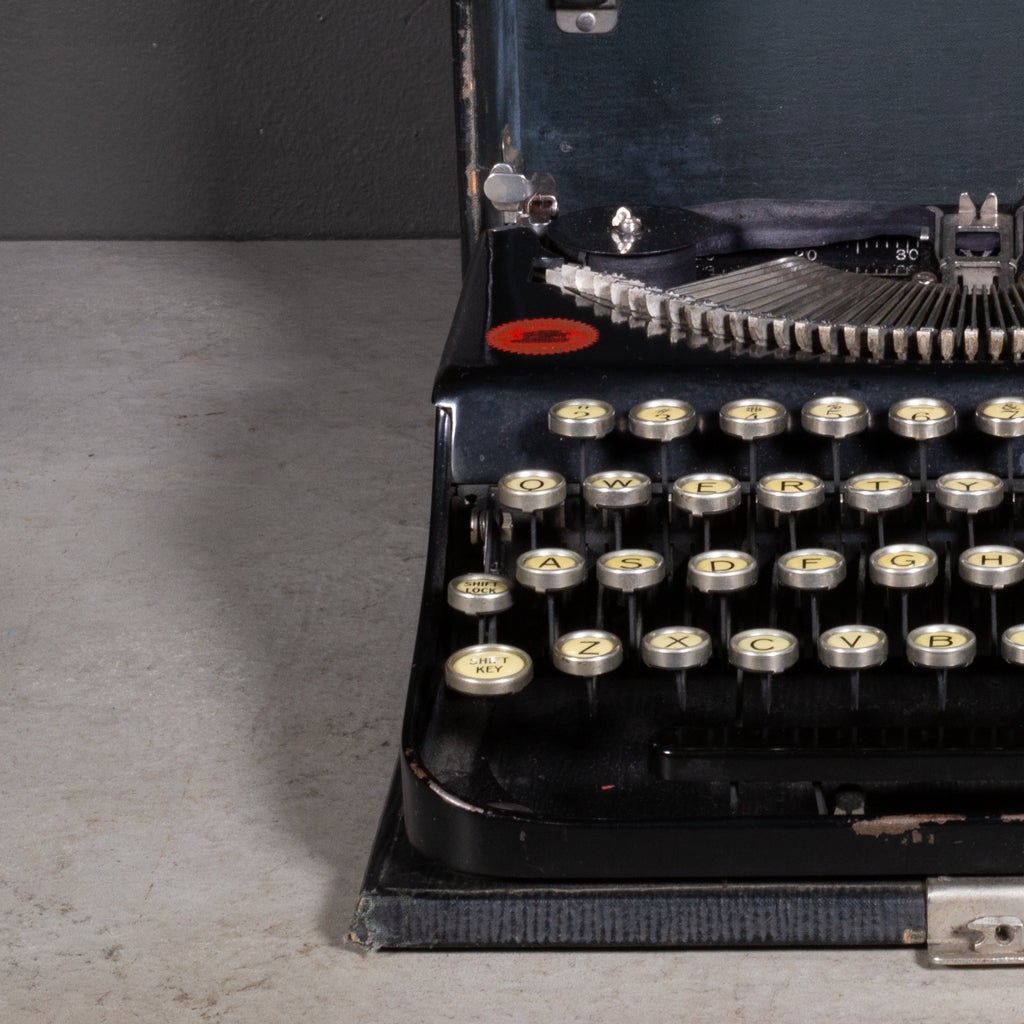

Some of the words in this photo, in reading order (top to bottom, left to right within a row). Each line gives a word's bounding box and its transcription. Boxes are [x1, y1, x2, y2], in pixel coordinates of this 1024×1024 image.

[896, 249, 918, 261] 30
[911, 412, 931, 421] 6
[603, 479, 632, 488] W
[696, 482, 717, 493] E
[781, 480, 804, 492] R
[866, 481, 889, 491] T
[958, 481, 979, 491] Y
[539, 557, 561, 569] A
[620, 558, 642, 569] S
[710, 560, 735, 572] D
[802, 558, 822, 569] F
[890, 554, 915, 567] G
[981, 555, 1003, 565] H
[666, 636, 689, 648] X
[750, 638, 774, 651] C
[840, 635, 862, 648] V
[929, 635, 954, 648] B
[578, 641, 601, 655] Z
[476, 665, 504, 674] KEY
